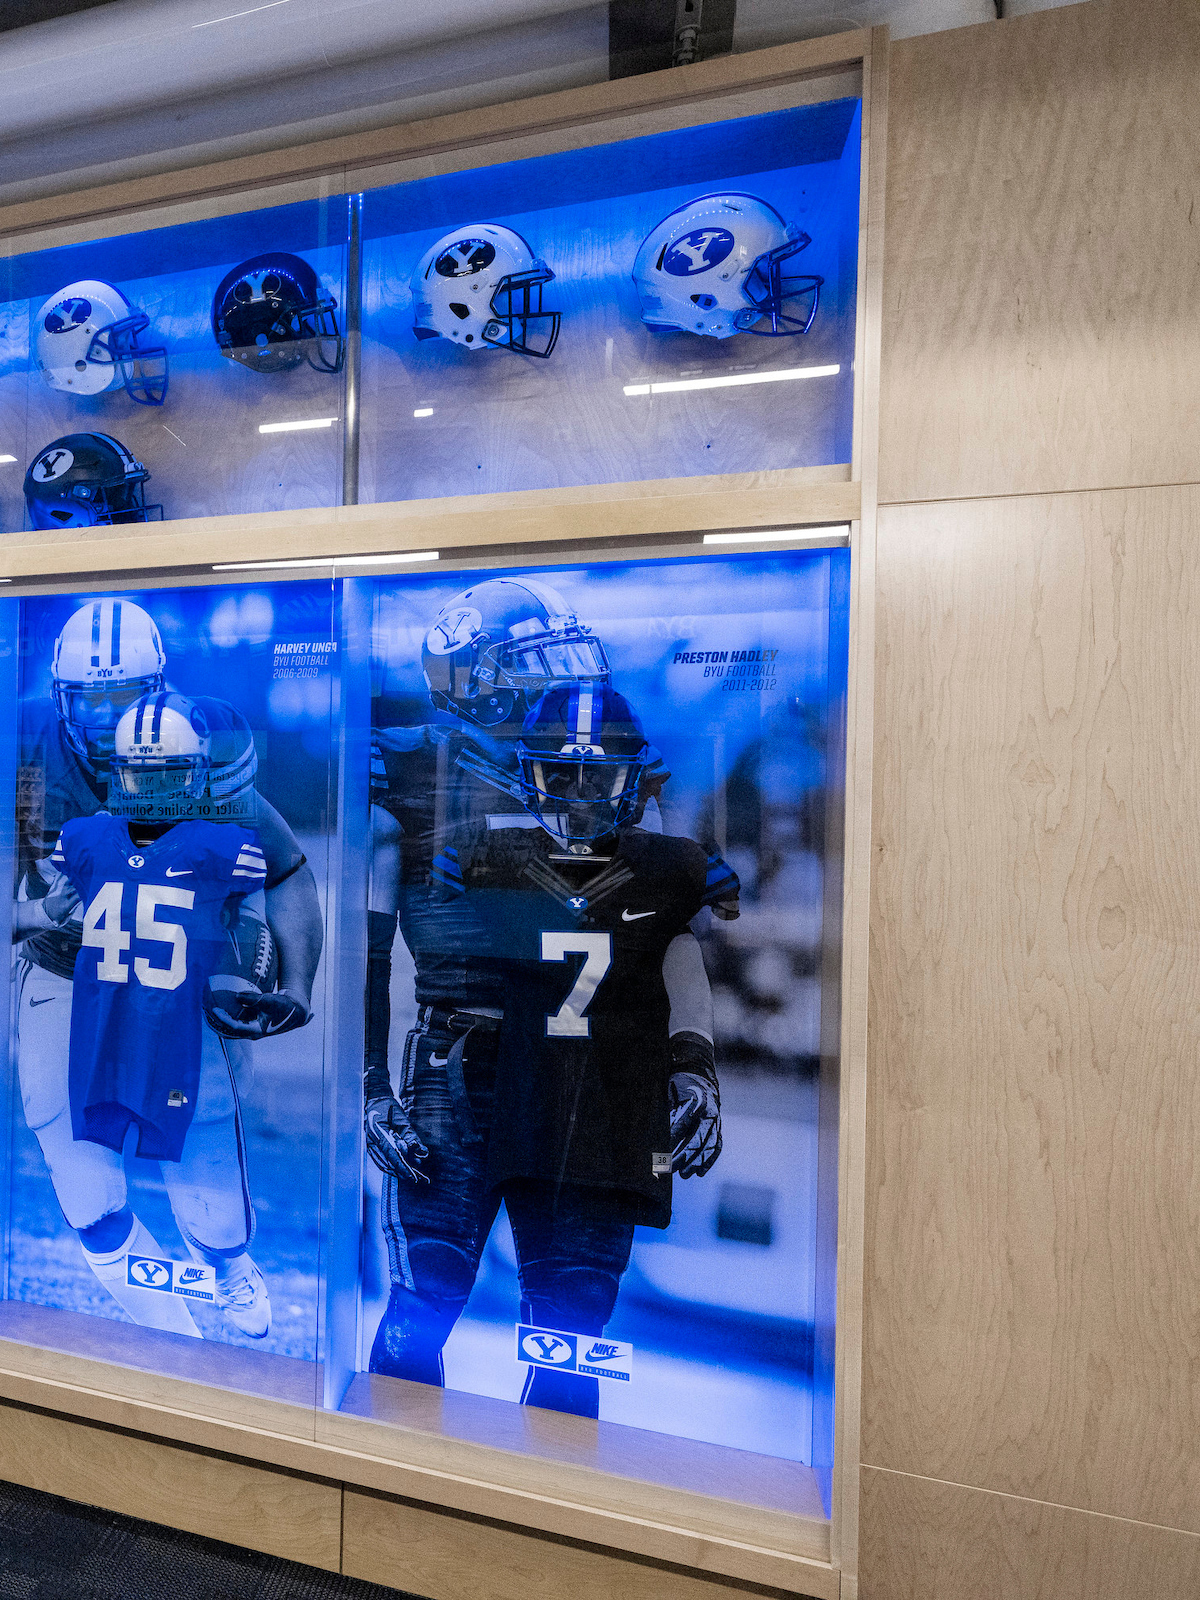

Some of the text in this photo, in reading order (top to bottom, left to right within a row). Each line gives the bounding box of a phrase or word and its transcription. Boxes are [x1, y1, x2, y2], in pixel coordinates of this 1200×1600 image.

[452, 241, 485, 273] Y
[670, 232, 716, 272] Y
[244, 271, 270, 301] Y
[52, 300, 85, 329] Y
[38, 451, 66, 478] Y
[434, 611, 472, 650] Y
[273, 641, 338, 654] HARVEY UNGA
[273, 655, 329, 667] BYU FOOTBALL
[673, 649, 779, 665] PRESTON HADLEY
[97, 668, 113, 678] BYU
[273, 667, 319, 679] 2006-2009
[703, 664, 776, 678] BYU FOOTBALL
[722, 678, 777, 692] 2011-2012
[139, 745, 153, 754] BYU
[569, 897, 585, 908] Y
[81, 881, 196, 991] 45
[539, 929, 614, 1040] 7
[137, 1262, 163, 1284] Y
[183, 1267, 205, 1279] NIKE
[530, 1335, 564, 1360] Y
[590, 1342, 619, 1356] NIKE
[595, 1368, 628, 1380] FOOTBALL
